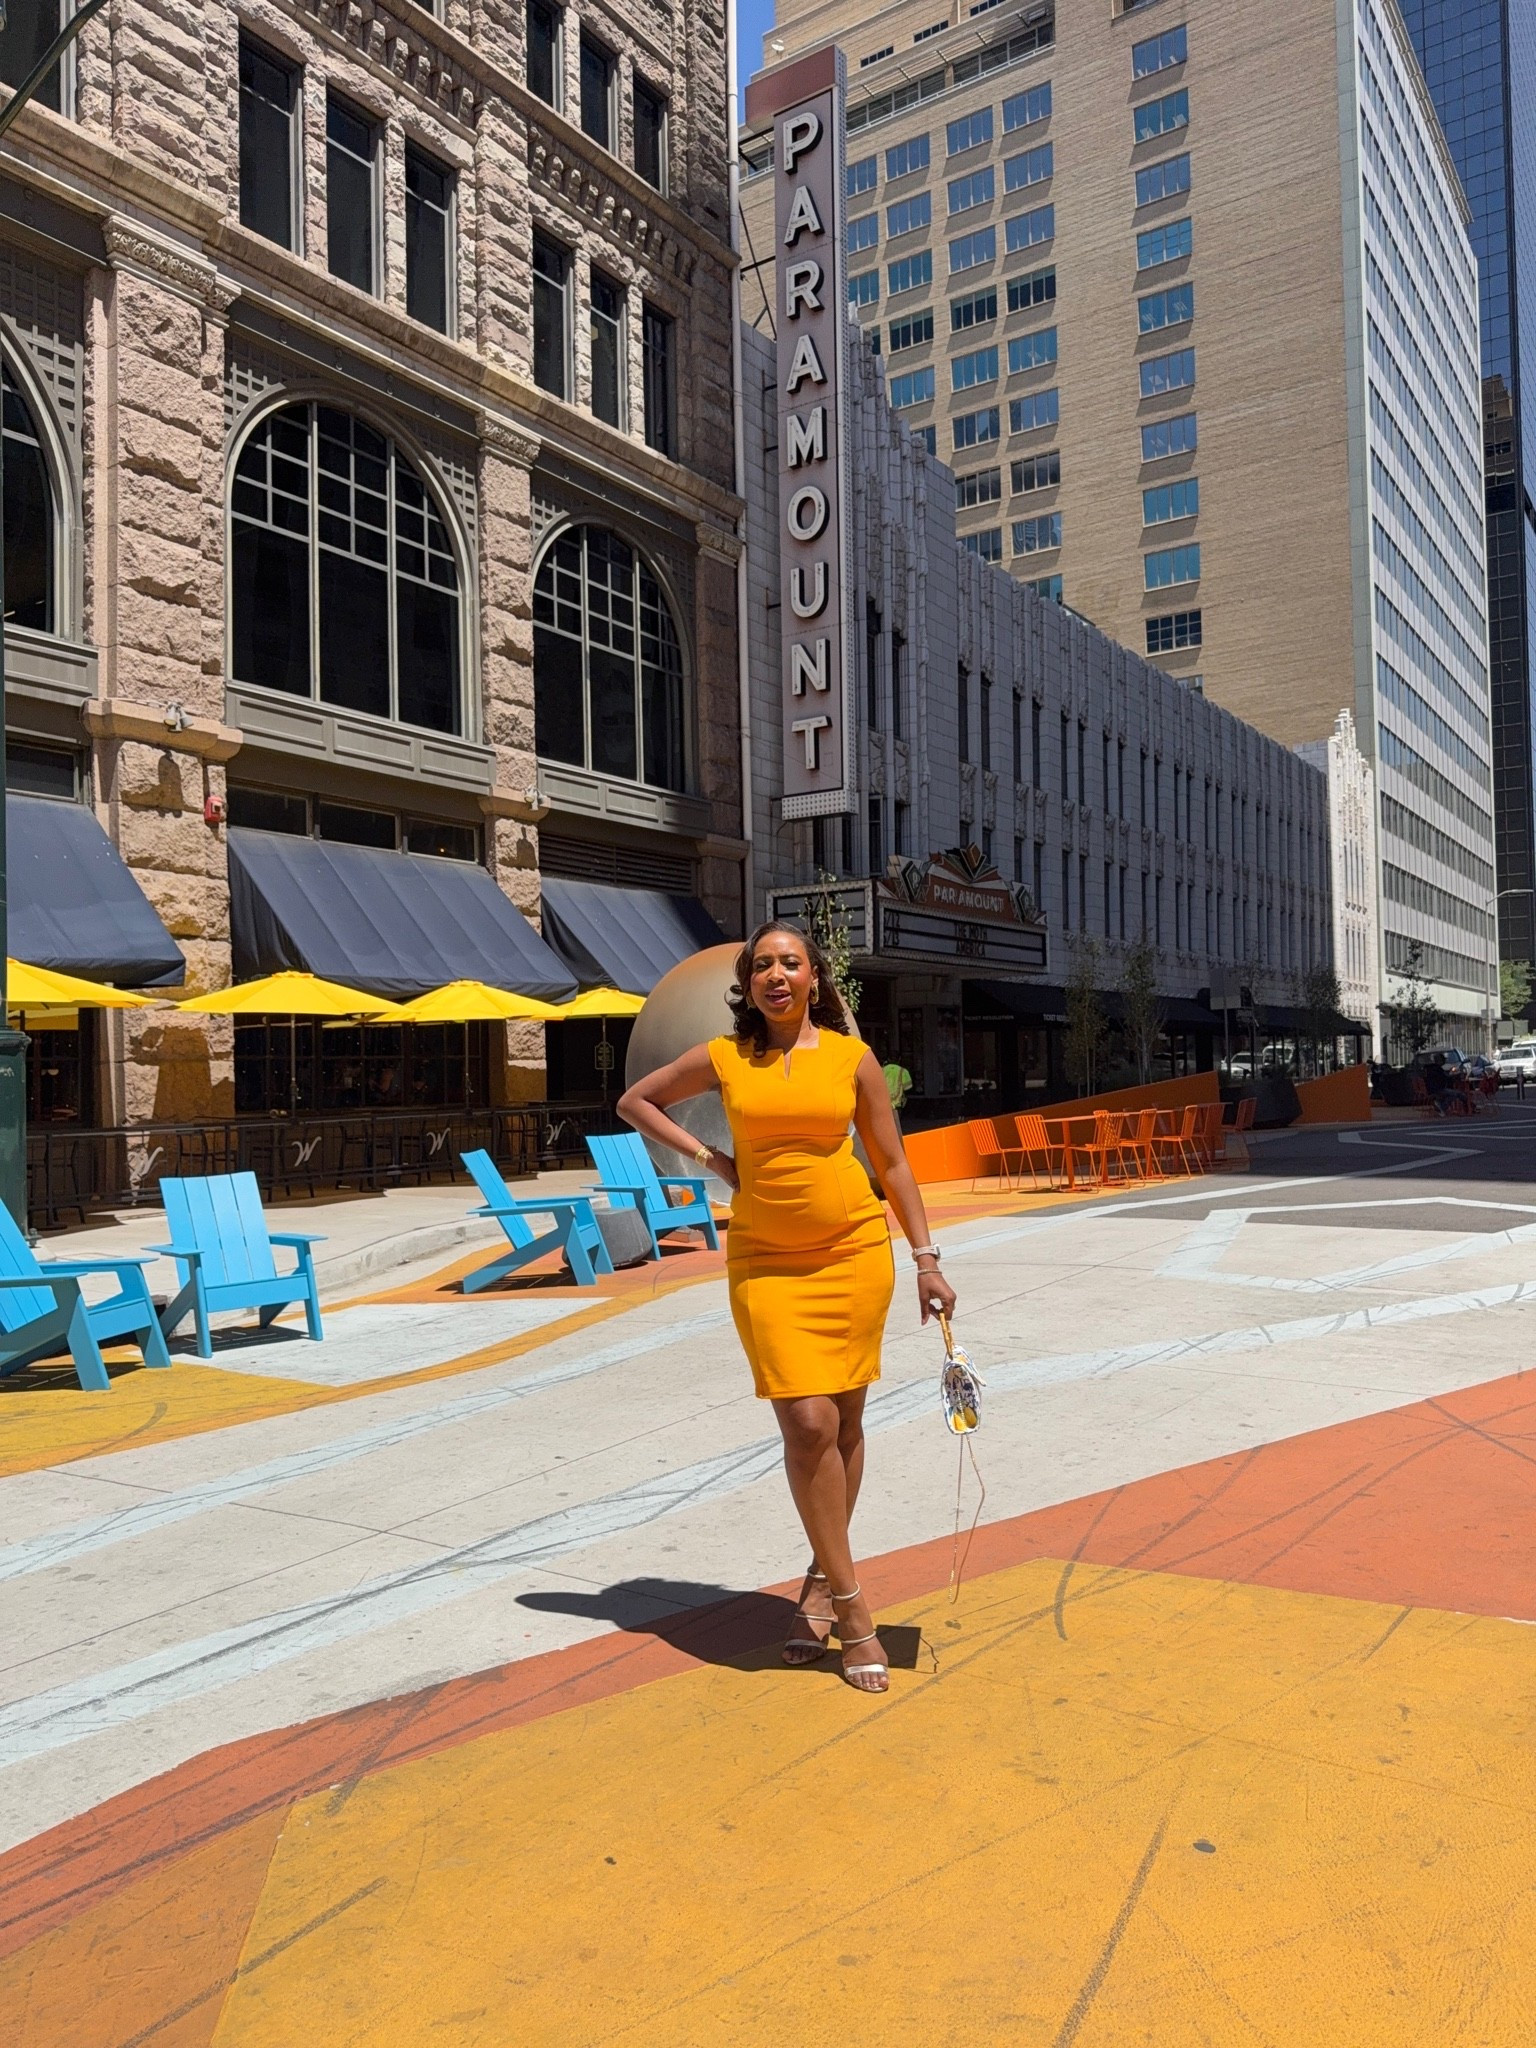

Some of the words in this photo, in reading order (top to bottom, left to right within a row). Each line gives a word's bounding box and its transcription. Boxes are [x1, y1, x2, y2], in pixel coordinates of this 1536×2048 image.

[783, 112, 832, 771] PARAMOUNT
[933, 884, 1004, 913] PARAMOUNT
[954, 923, 967, 938] THE
[956, 940, 986, 957] AMERICA
[291, 1136, 322, 1167] W
[426, 1127, 451, 1156] W
